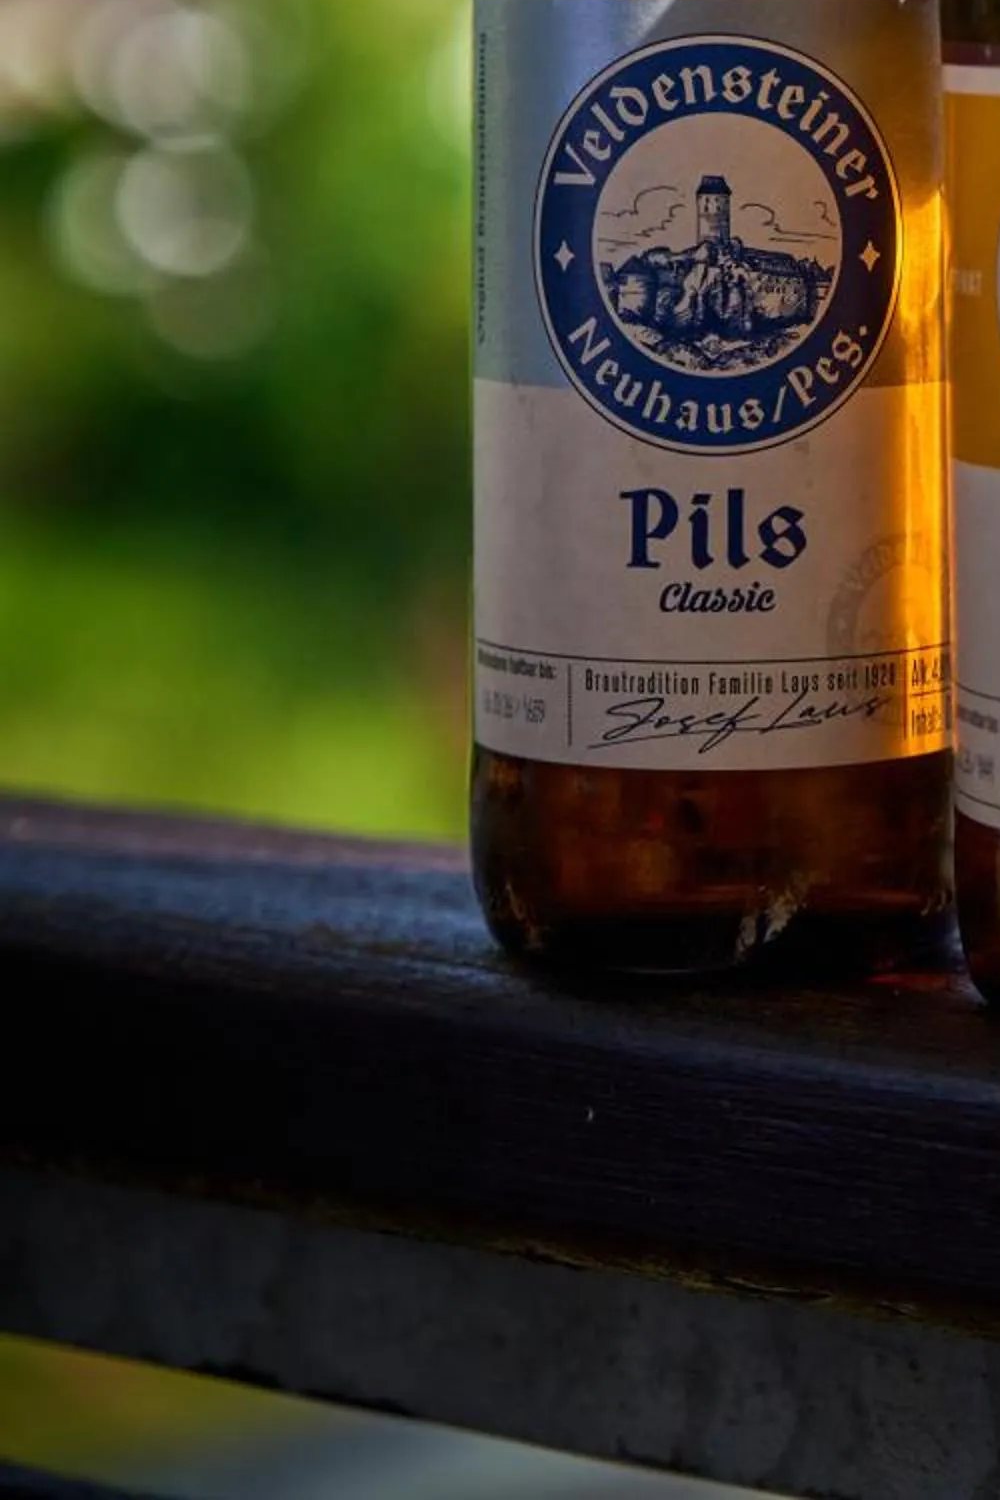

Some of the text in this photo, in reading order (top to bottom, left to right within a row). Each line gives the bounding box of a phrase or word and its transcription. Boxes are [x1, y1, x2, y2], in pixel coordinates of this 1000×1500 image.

[554, 63, 879, 203] Veldensteiner
[567, 316, 868, 434] Neuhaus/Peg.
[619, 487, 808, 570] Pils
[659, 581, 776, 614] Classic
[585, 667, 699, 695] Brautradition
[709, 670, 774, 696] Familie
[827, 668, 858, 692] seit
